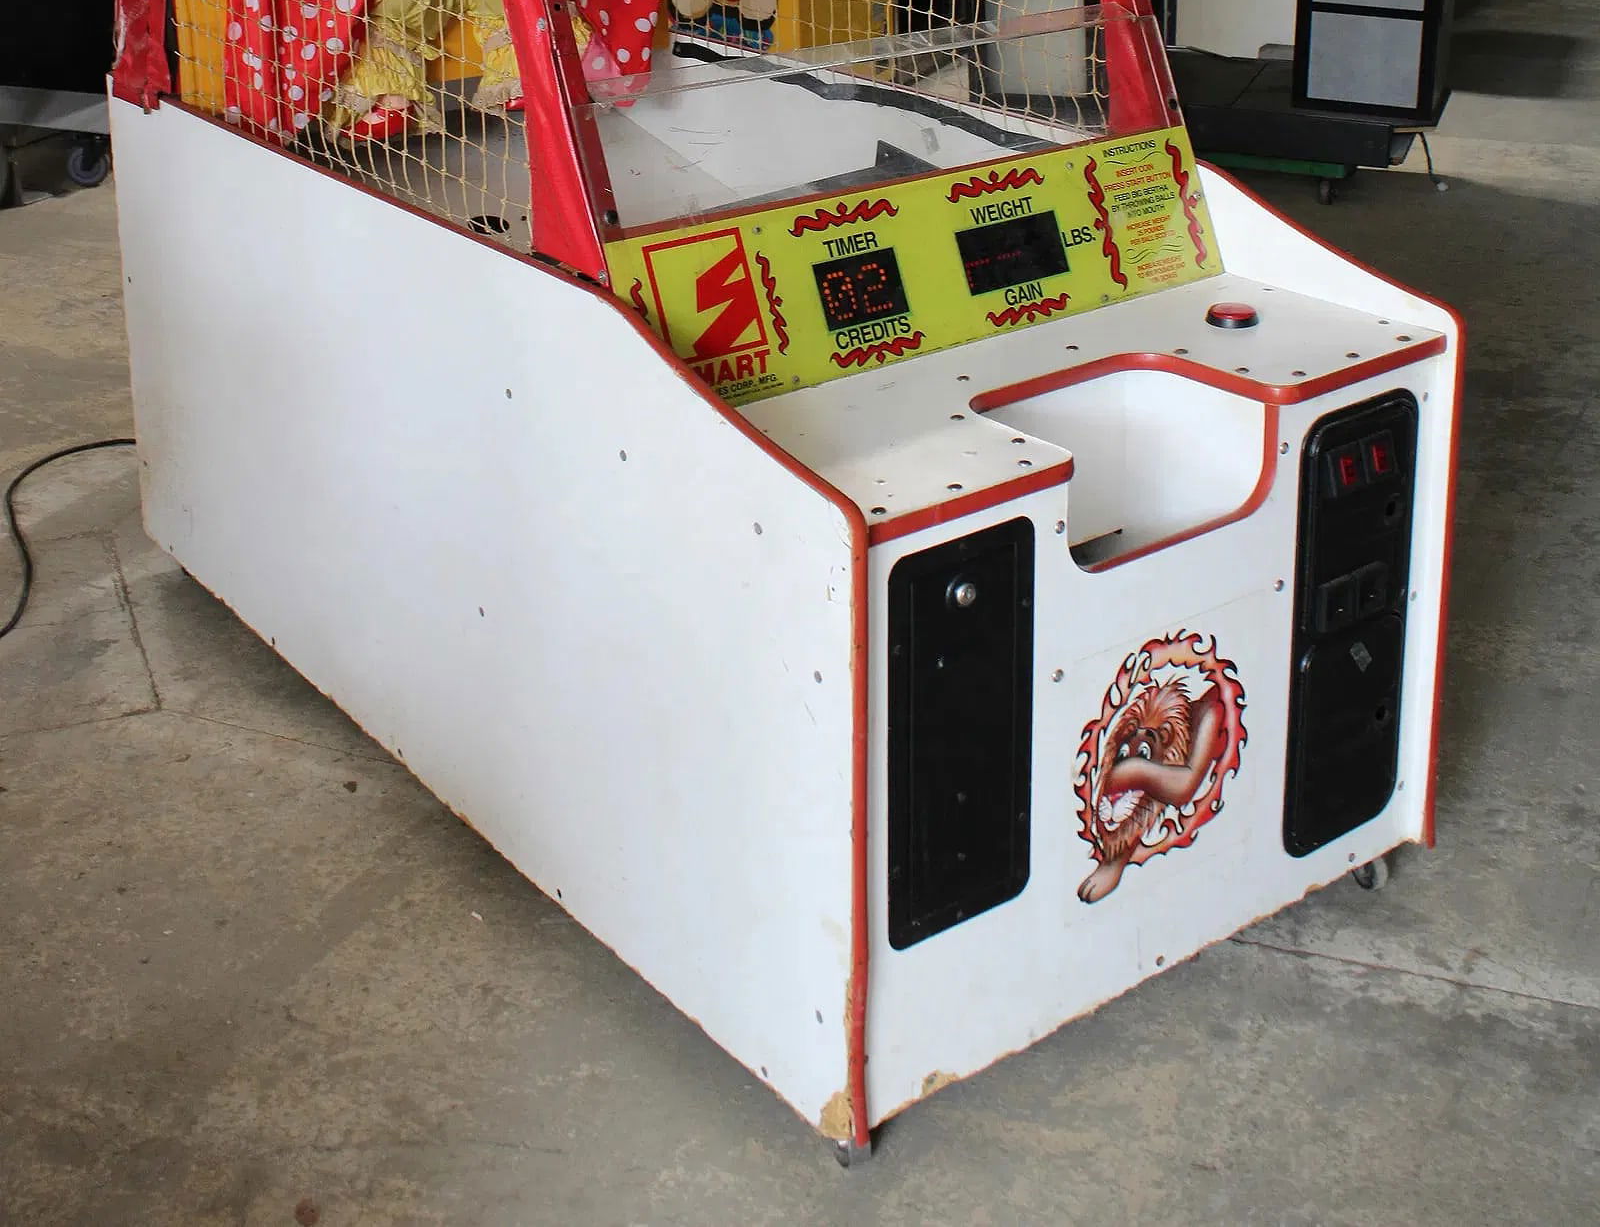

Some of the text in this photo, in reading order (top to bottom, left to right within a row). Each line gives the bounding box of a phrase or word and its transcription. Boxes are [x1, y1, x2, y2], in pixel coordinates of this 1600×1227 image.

[1103, 139, 1156, 158] INSTRUCTIONS
[1103, 171, 1172, 192] PRESS START BUTTON
[1115, 166, 1137, 178] INSERT
[1111, 204, 1120, 213] BY
[1155, 191, 1175, 203] BALLS
[1113, 184, 1169, 202] FEED BIG BERTHA
[970, 196, 1032, 225] WEIGHT
[1142, 203, 1165, 215] MOUTH
[822, 231, 879, 258] TIMER
[1062, 226, 1096, 248] LBS.
[1005, 282, 1044, 305] GAIN
[835, 316, 912, 350] CREDITS
